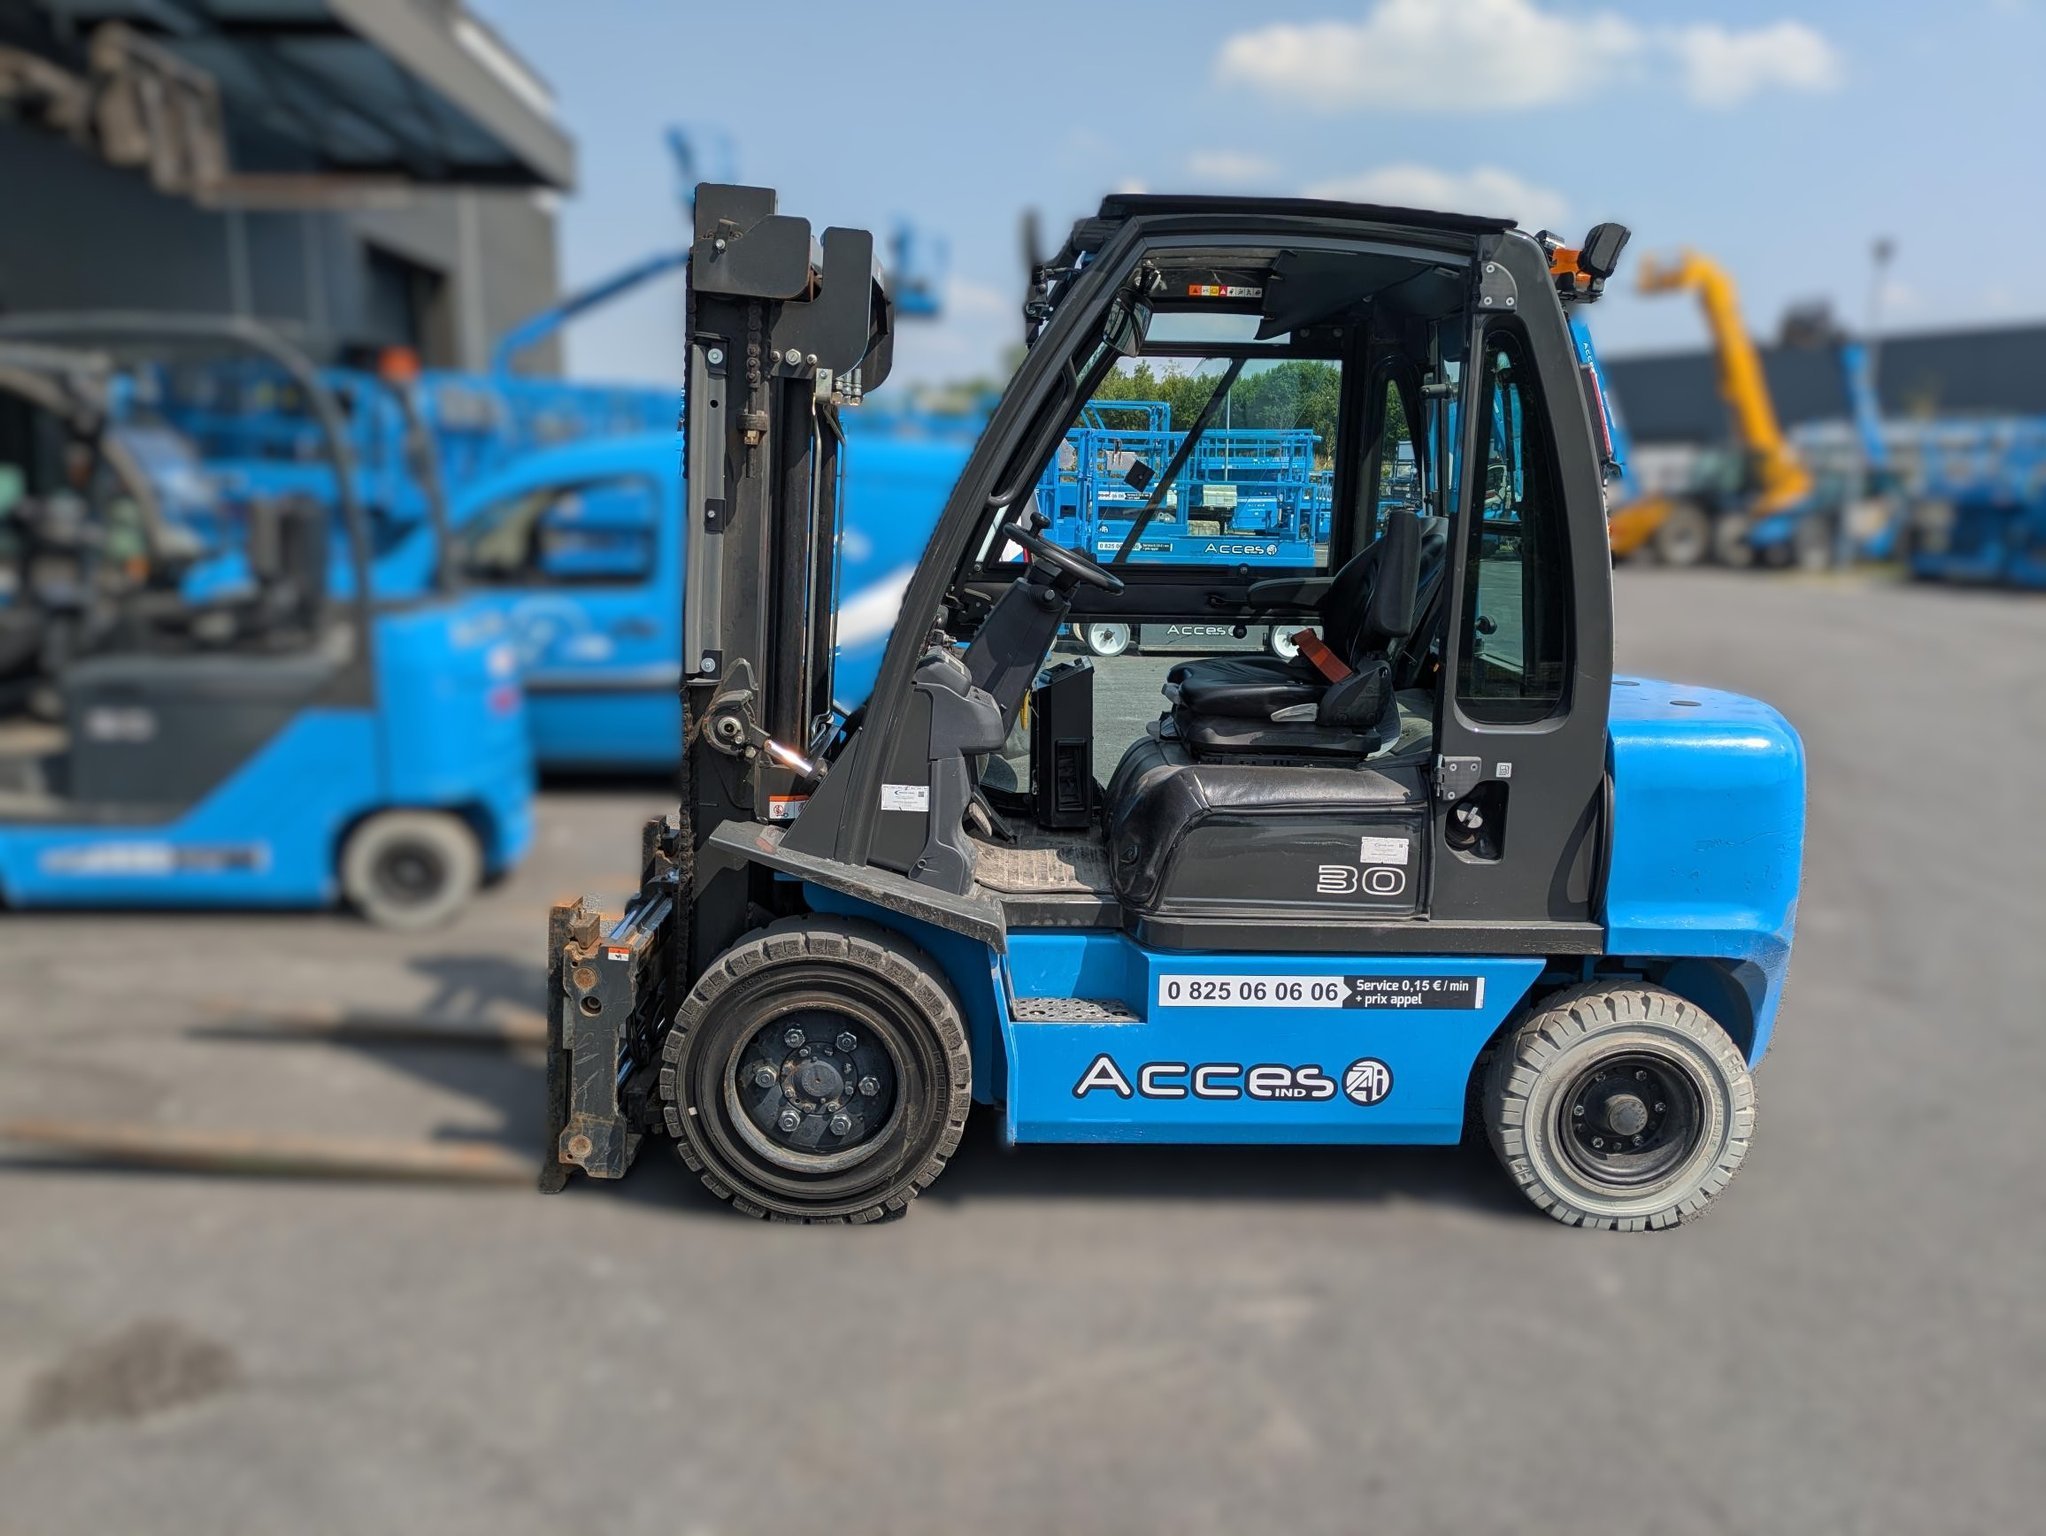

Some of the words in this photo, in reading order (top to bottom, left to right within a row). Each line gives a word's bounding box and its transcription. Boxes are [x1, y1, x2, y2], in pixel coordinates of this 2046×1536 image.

[1204, 543, 1265, 555] Acces
[1166, 624, 1227, 636] Acces
[1317, 865, 1406, 896] 30
[1167, 981, 1181, 1000] 0
[1189, 981, 1231, 1000] 825
[1239, 982, 1267, 1000] 06
[1275, 982, 1303, 1001] 06
[1311, 982, 1338, 1001] 06
[1356, 979, 1399, 992] Service
[1402, 980, 1430, 993] 0,15
[1364, 993, 1388, 1007] prix
[1391, 994, 1422, 1008] appel
[1074, 1055, 1335, 1099] Acces
[1275, 1088, 1306, 1098] IND
